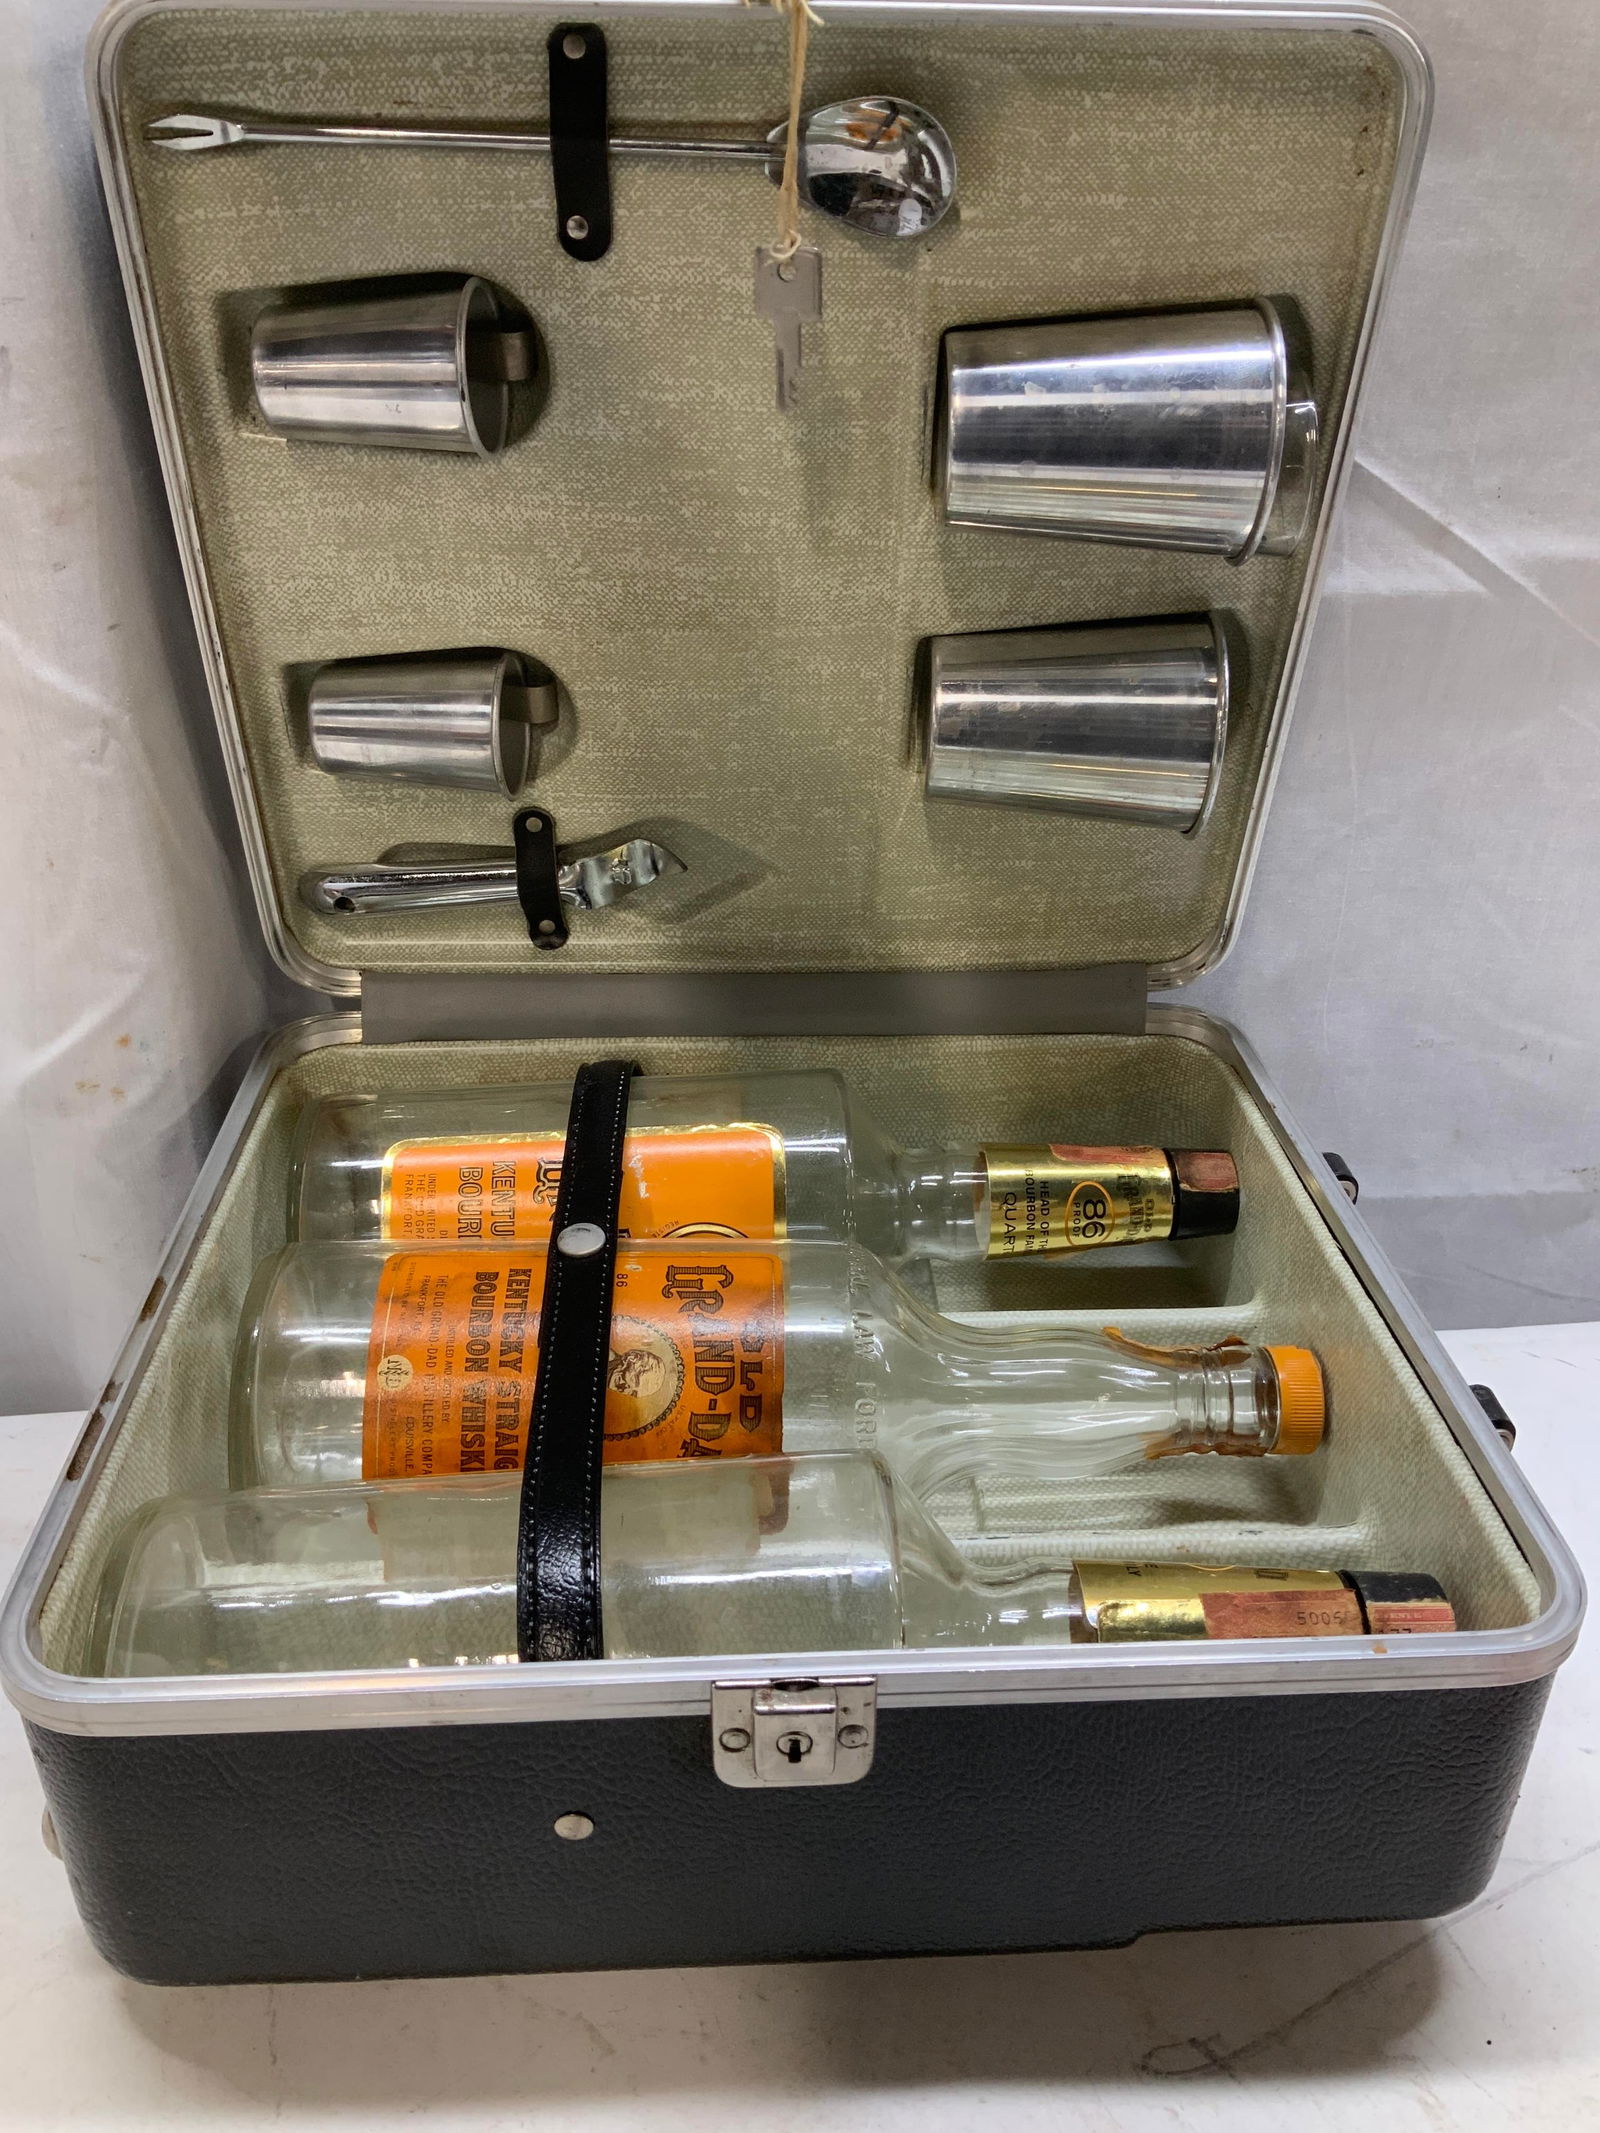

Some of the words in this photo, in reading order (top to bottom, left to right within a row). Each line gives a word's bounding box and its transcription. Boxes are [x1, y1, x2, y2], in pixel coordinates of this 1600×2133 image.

[416, 1173, 426, 1192] THE
[1025, 1169, 1036, 1231] BOURBON
[1040, 1181, 1050, 1217] HEAD
[1002, 1192, 1017, 1254] QUART
[1040, 1221, 1050, 1237] OF
[1073, 1202, 1081, 1237] PROOF
[1082, 1200, 1107, 1238] 86
[436, 1275, 449, 1288] THE
[616, 1273, 629, 1288] 86
[433, 1290, 446, 1308] OLD
[464, 1271, 500, 1373] BOURBON
[499, 1268, 532, 1374] KENTUCKY
[443, 1360, 454, 1376] AND
[739, 1319, 769, 1432] OLD
